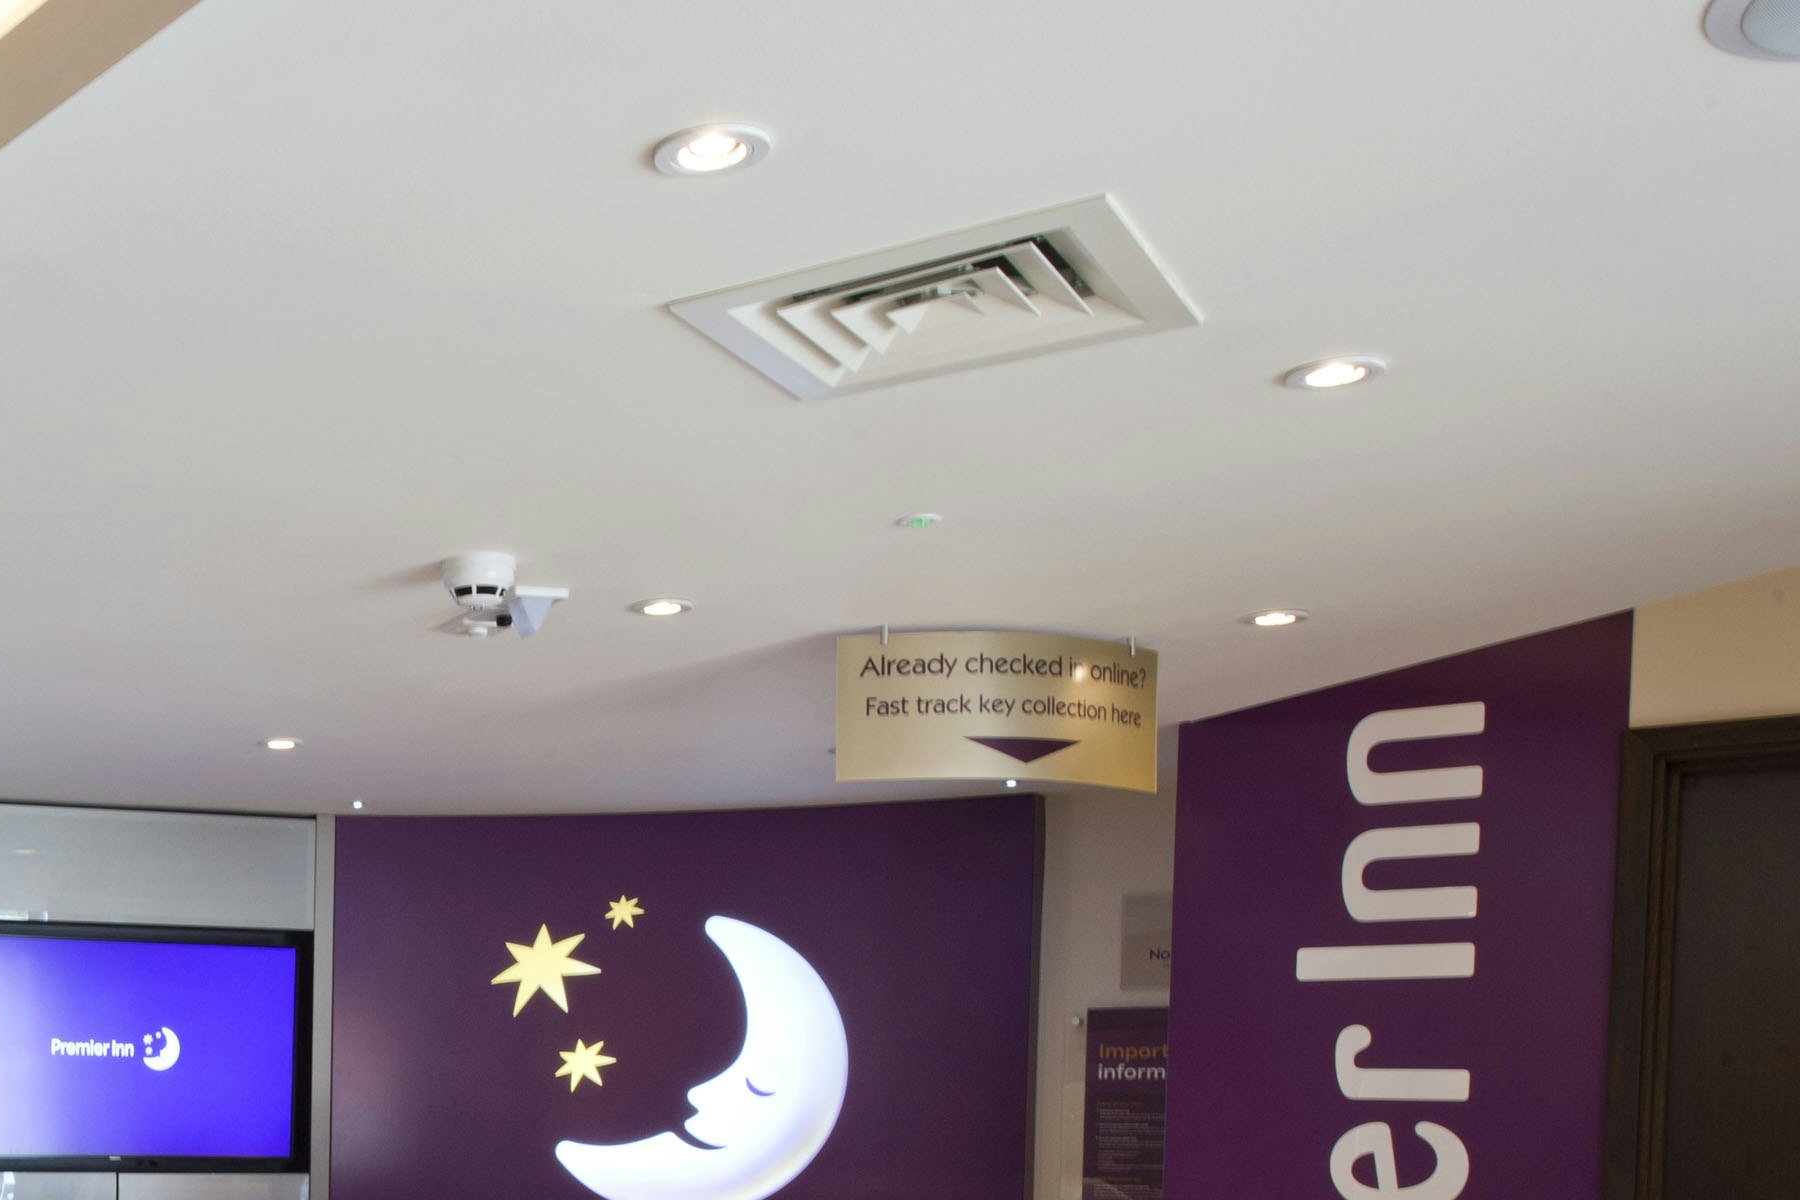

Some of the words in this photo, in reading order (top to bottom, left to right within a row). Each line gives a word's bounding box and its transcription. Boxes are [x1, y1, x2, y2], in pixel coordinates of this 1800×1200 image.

[860, 653, 957, 678] Already
[965, 655, 1062, 677] checked
[1090, 662, 1147, 689] online?
[865, 696, 909, 717] Fast
[917, 694, 971, 715] track
[979, 694, 1015, 718] key
[1022, 696, 1106, 721] collection
[1111, 705, 1141, 727] here
[1295, 701, 1486, 983] Inn
[51, 1038, 110, 1056] Premier
[1098, 1062, 1166, 1080] inform
